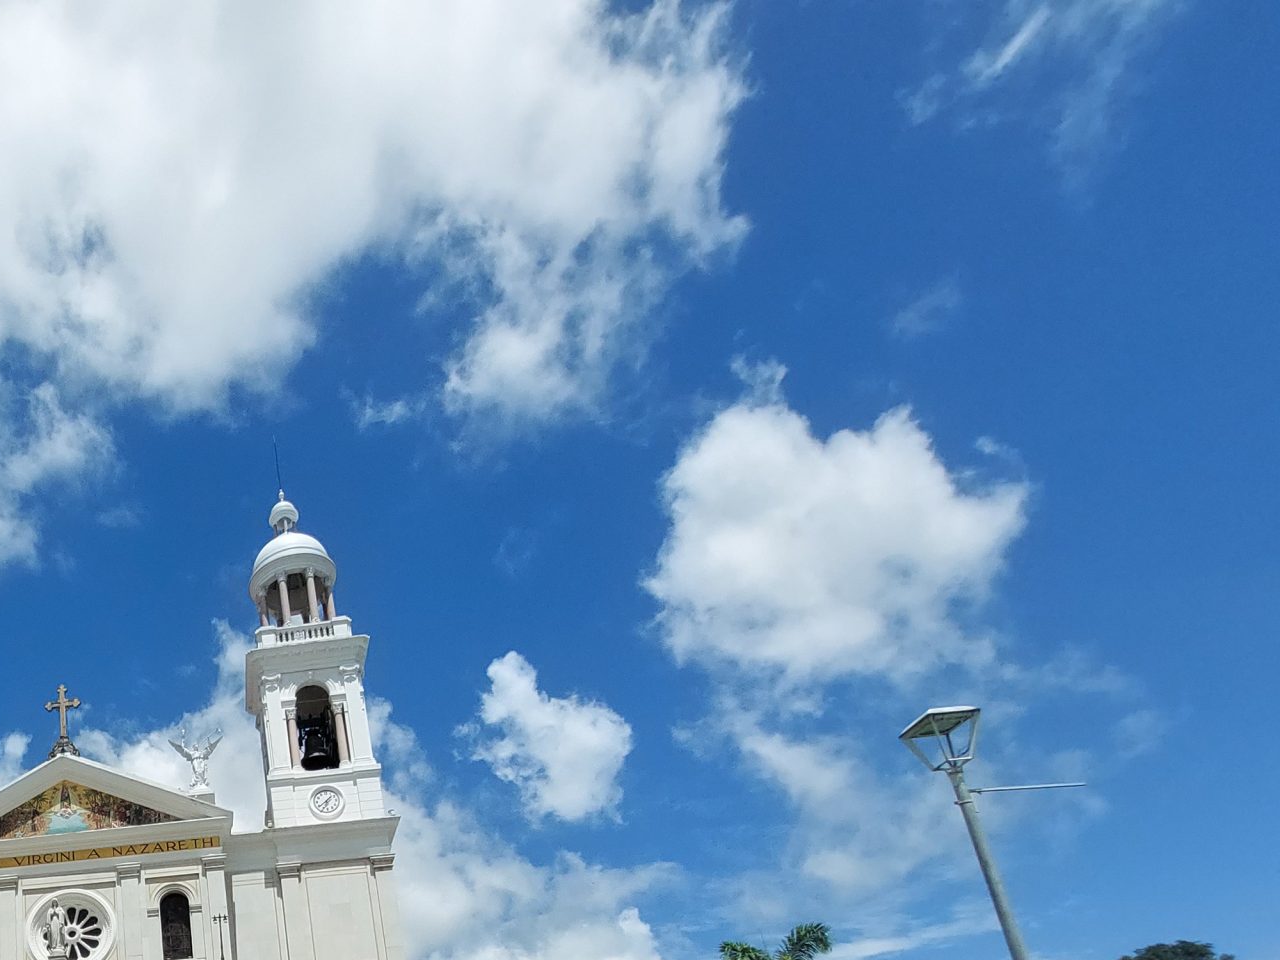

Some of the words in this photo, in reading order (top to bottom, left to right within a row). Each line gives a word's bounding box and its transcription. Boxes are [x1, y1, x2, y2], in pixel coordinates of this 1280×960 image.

[13, 850, 76, 867] VIRGINI
[87, 848, 101, 859] A
[111, 836, 214, 856] NAZARETH
